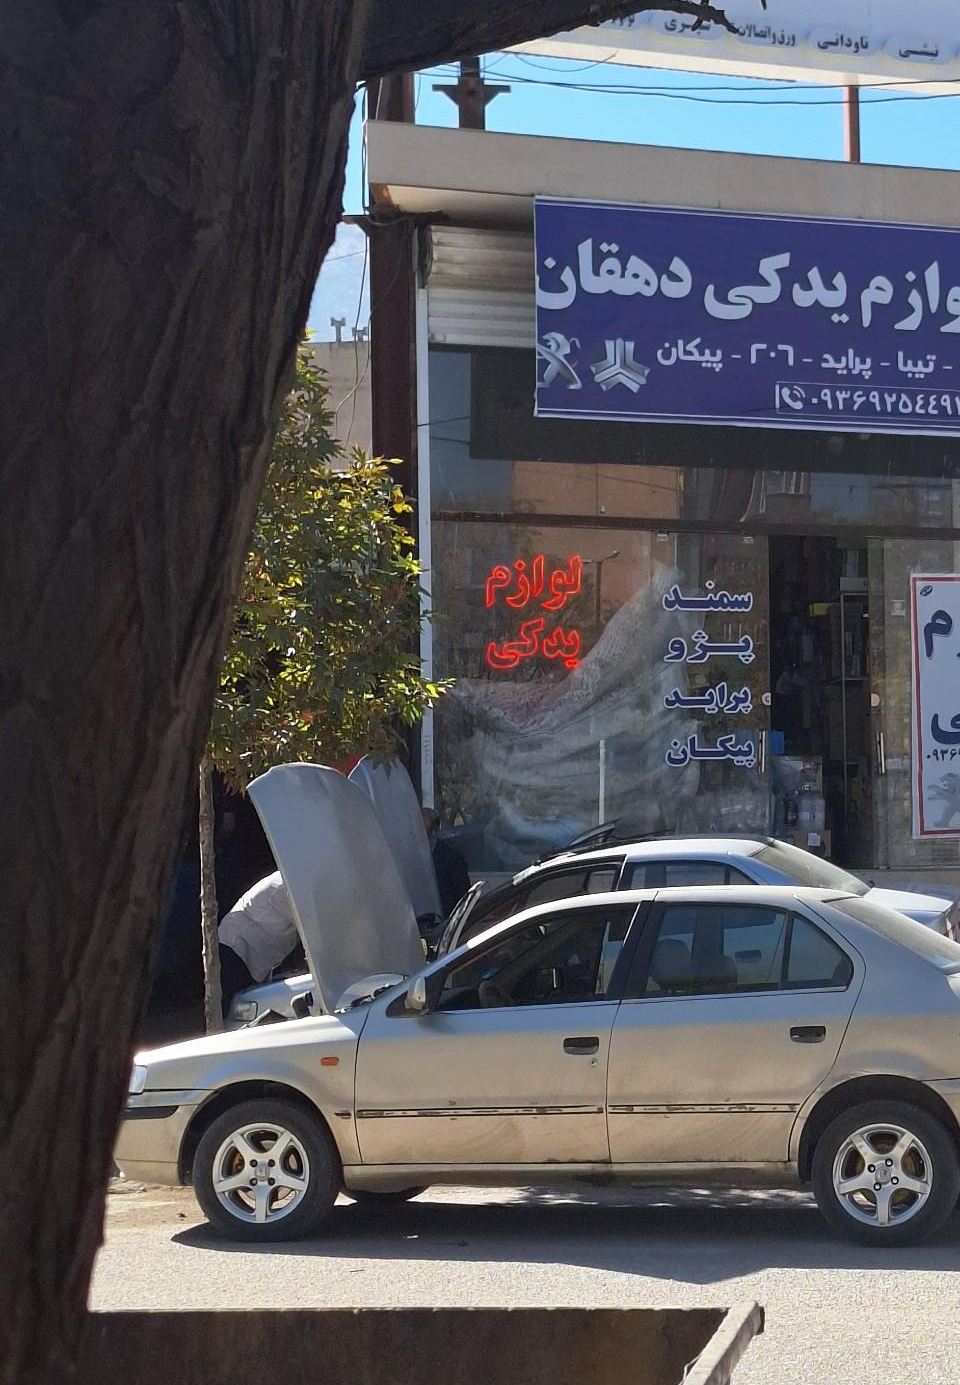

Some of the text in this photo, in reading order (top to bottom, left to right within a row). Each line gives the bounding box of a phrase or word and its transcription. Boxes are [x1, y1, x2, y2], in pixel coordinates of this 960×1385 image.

[816, 34, 869, 54] ناودانی
[898, 44, 939, 61] نبشی
[536, 237, 693, 310] دهقان
[703, 251, 850, 324] یدکی
[656, 338, 723, 372] پیکان
[820, 348, 873, 381] پراید
[897, 351, 935, 381] تیبا
[485, 553, 584, 611] لوازم
[662, 580, 754, 612] سمند
[485, 617, 582, 670] یدکی
[663, 629, 756, 664] پژو
[663, 681, 752, 715] پراید
[665, 733, 756, 768] پیکان
